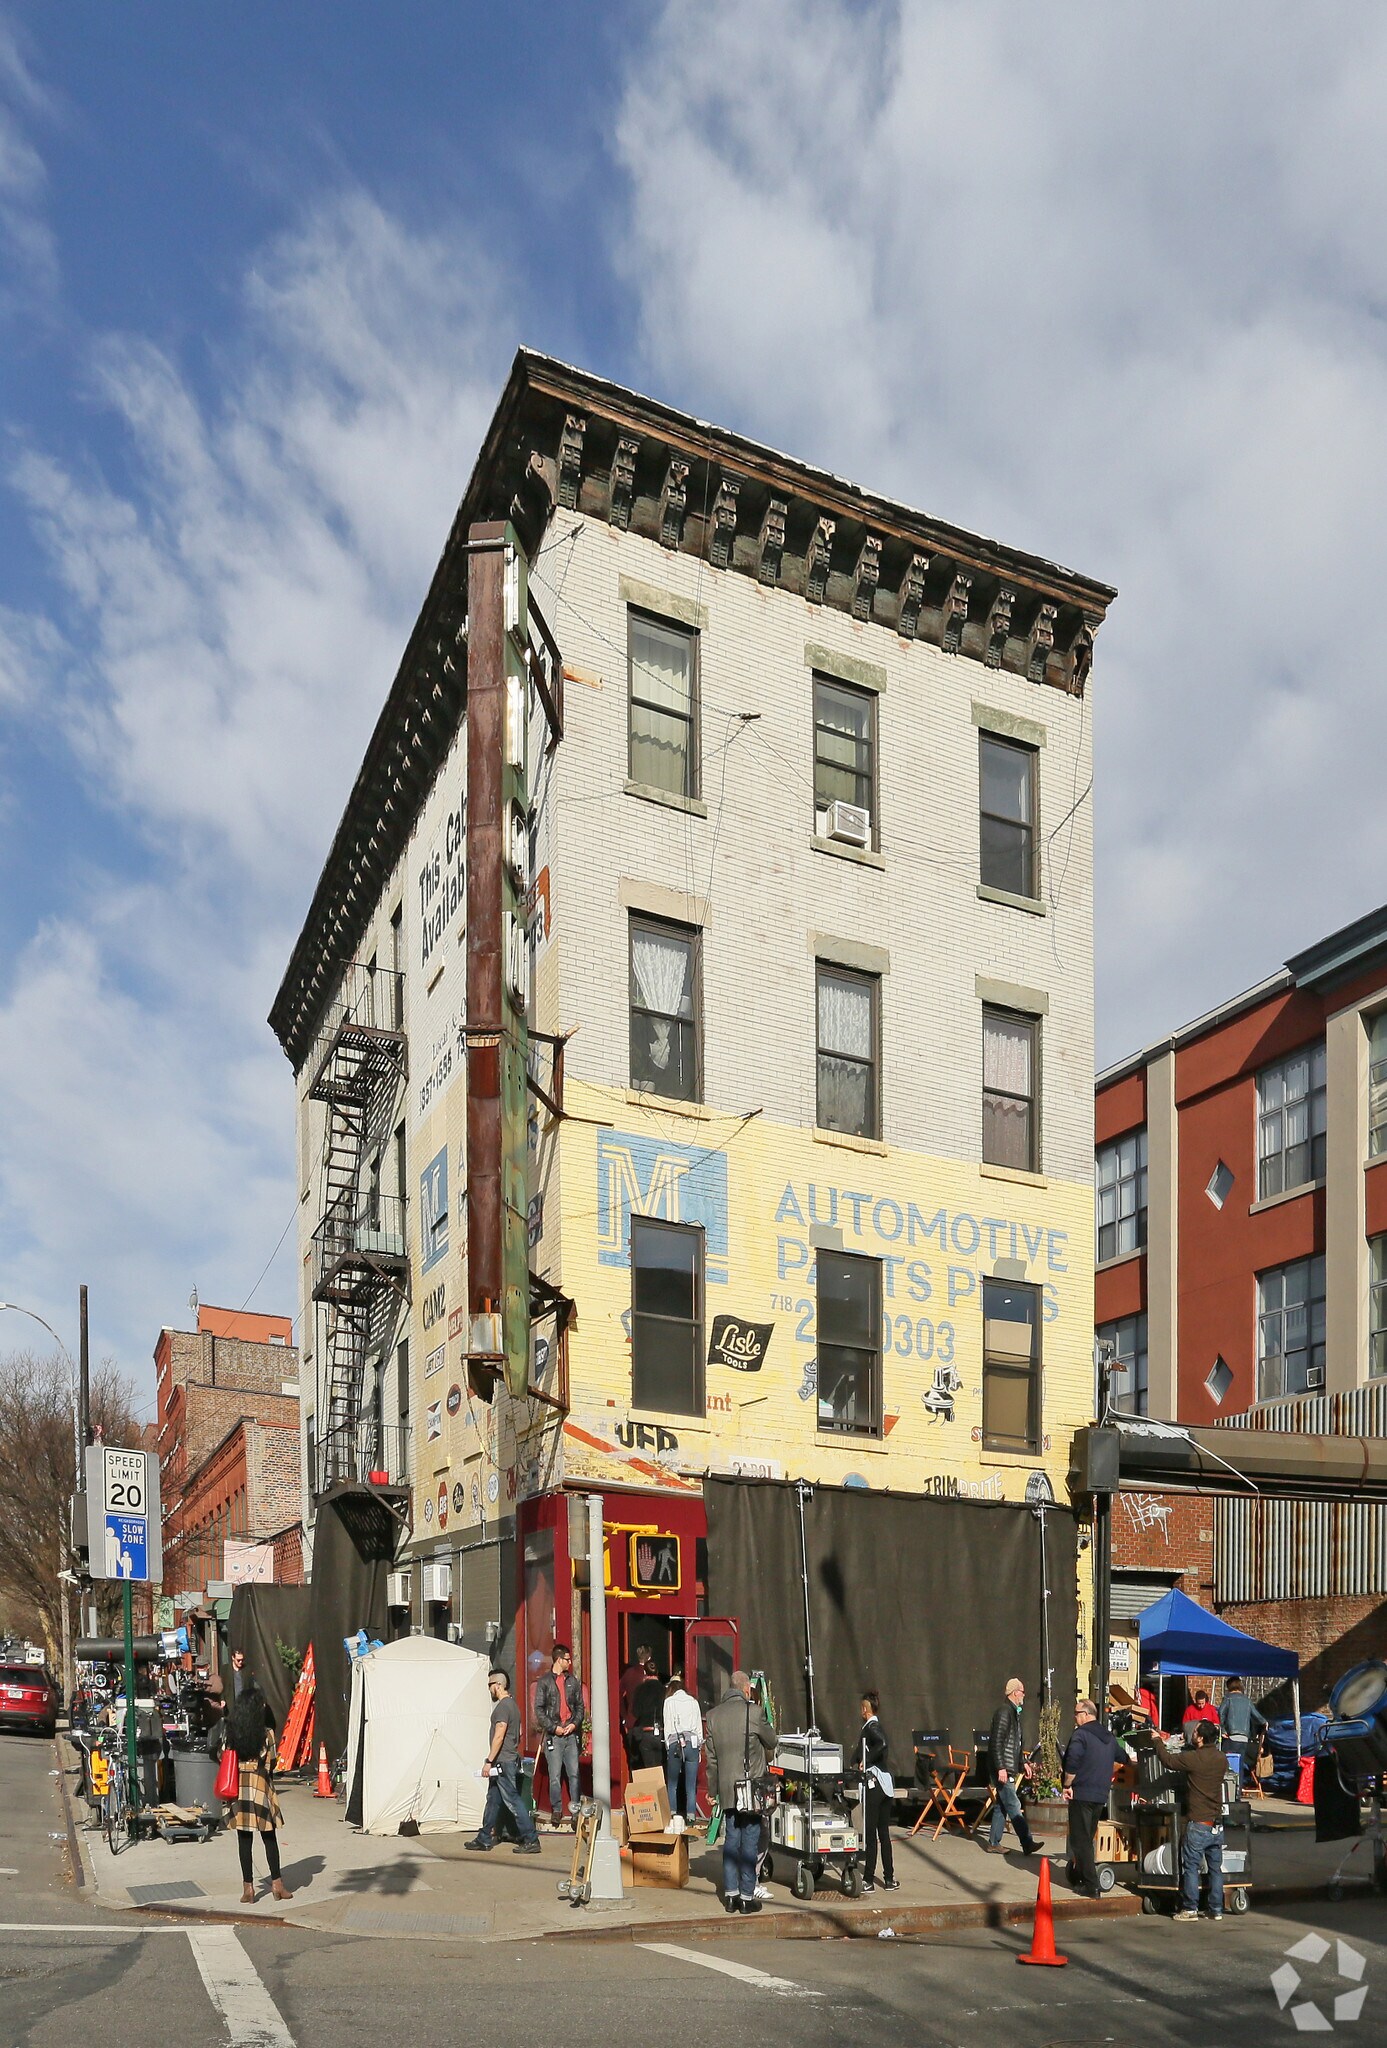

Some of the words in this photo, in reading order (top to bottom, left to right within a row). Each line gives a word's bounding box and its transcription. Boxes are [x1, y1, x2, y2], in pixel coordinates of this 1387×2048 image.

[418, 850, 441, 918] This
[774, 1181, 1070, 1273] AUTOMOTIVE
[776, 1235, 934, 1303] PTS
[769, 1293, 794, 1313] 718
[714, 1324, 762, 1360] Lisle
[722, 1353, 748, 1369] TOOLS
[109, 1456, 142, 1468] SPEED
[111, 1469, 140, 1481] LIMIT
[110, 1483, 142, 1507] 20
[122, 1524, 144, 1535] SLOW
[122, 1533, 145, 1545] ZONE
